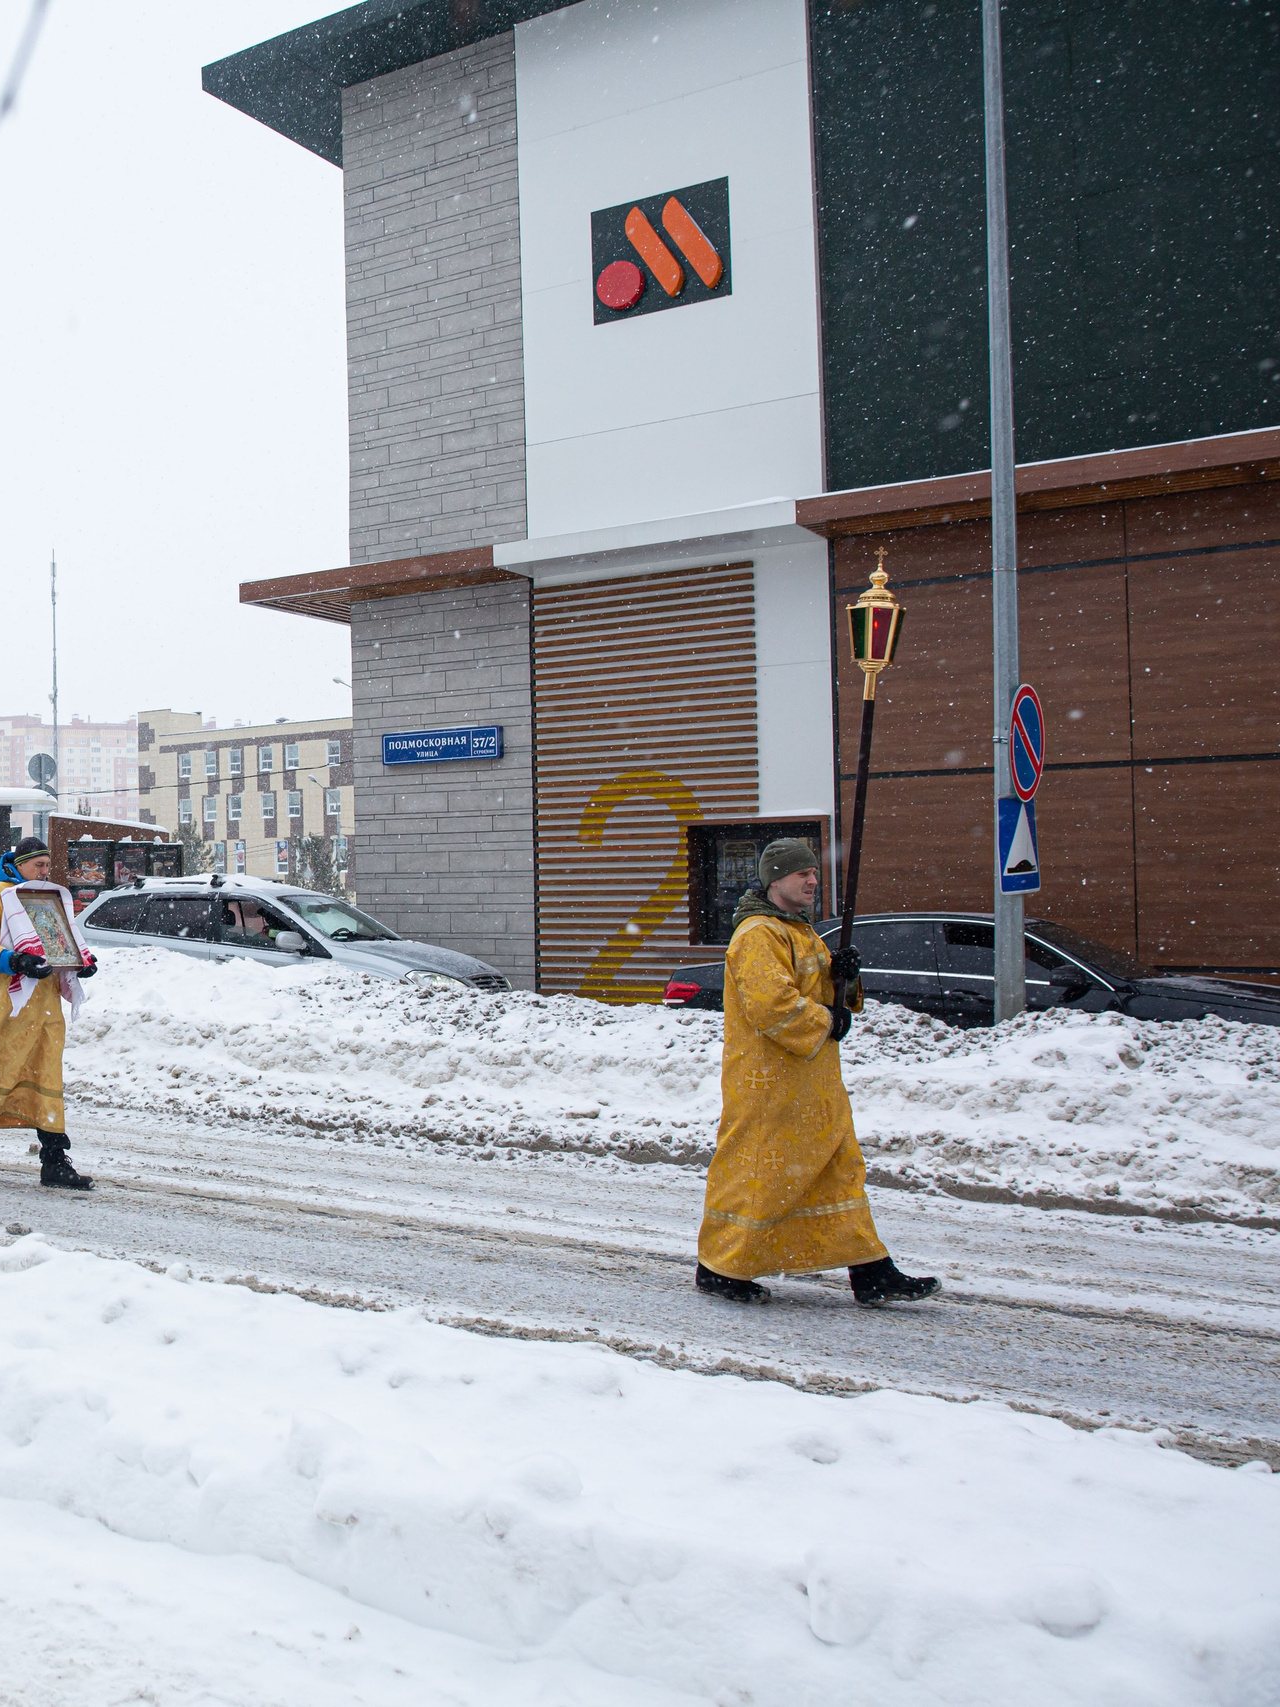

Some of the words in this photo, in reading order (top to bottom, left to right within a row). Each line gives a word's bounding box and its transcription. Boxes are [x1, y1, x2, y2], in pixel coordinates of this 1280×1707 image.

[388, 735, 467, 750] ПОДМОСКОВНАЯ
[472, 736, 496, 748] 37/2
[416, 750, 439, 758] УЛИЦА
[577, 770, 705, 1005] 2
